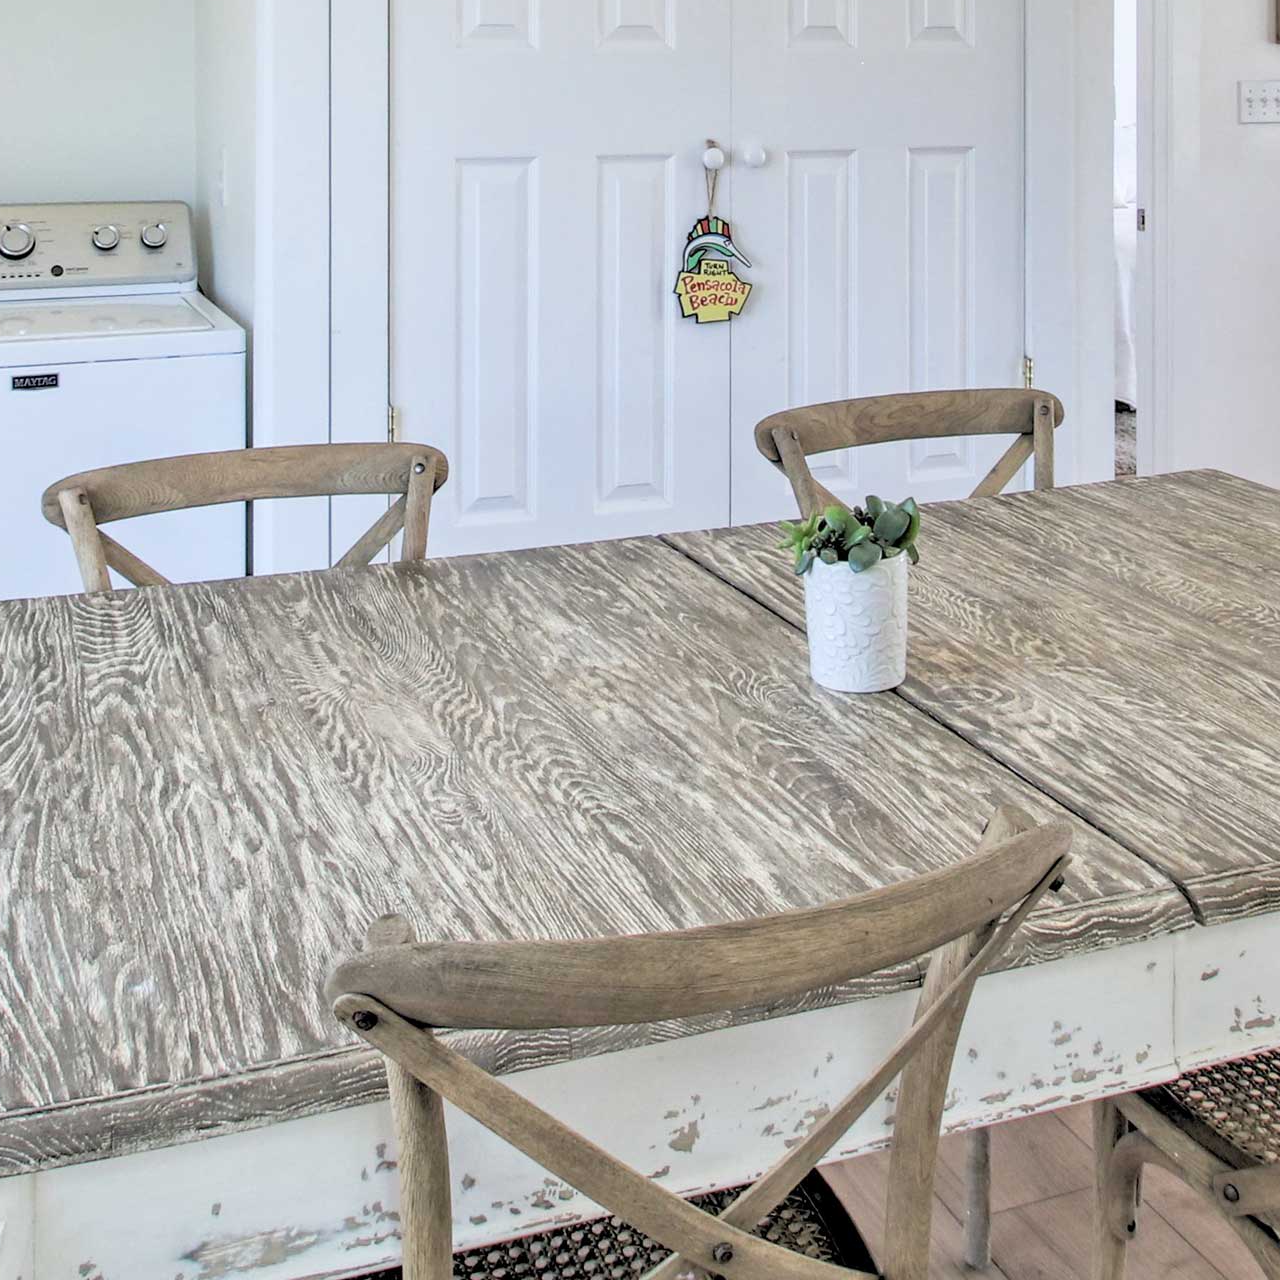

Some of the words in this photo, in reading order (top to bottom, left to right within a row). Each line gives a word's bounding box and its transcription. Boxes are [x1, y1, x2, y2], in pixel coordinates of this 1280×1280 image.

[681, 275, 746, 295] Pensacola
[689, 292, 738, 311] Beach
[13, 376, 57, 388] MAYTAG
